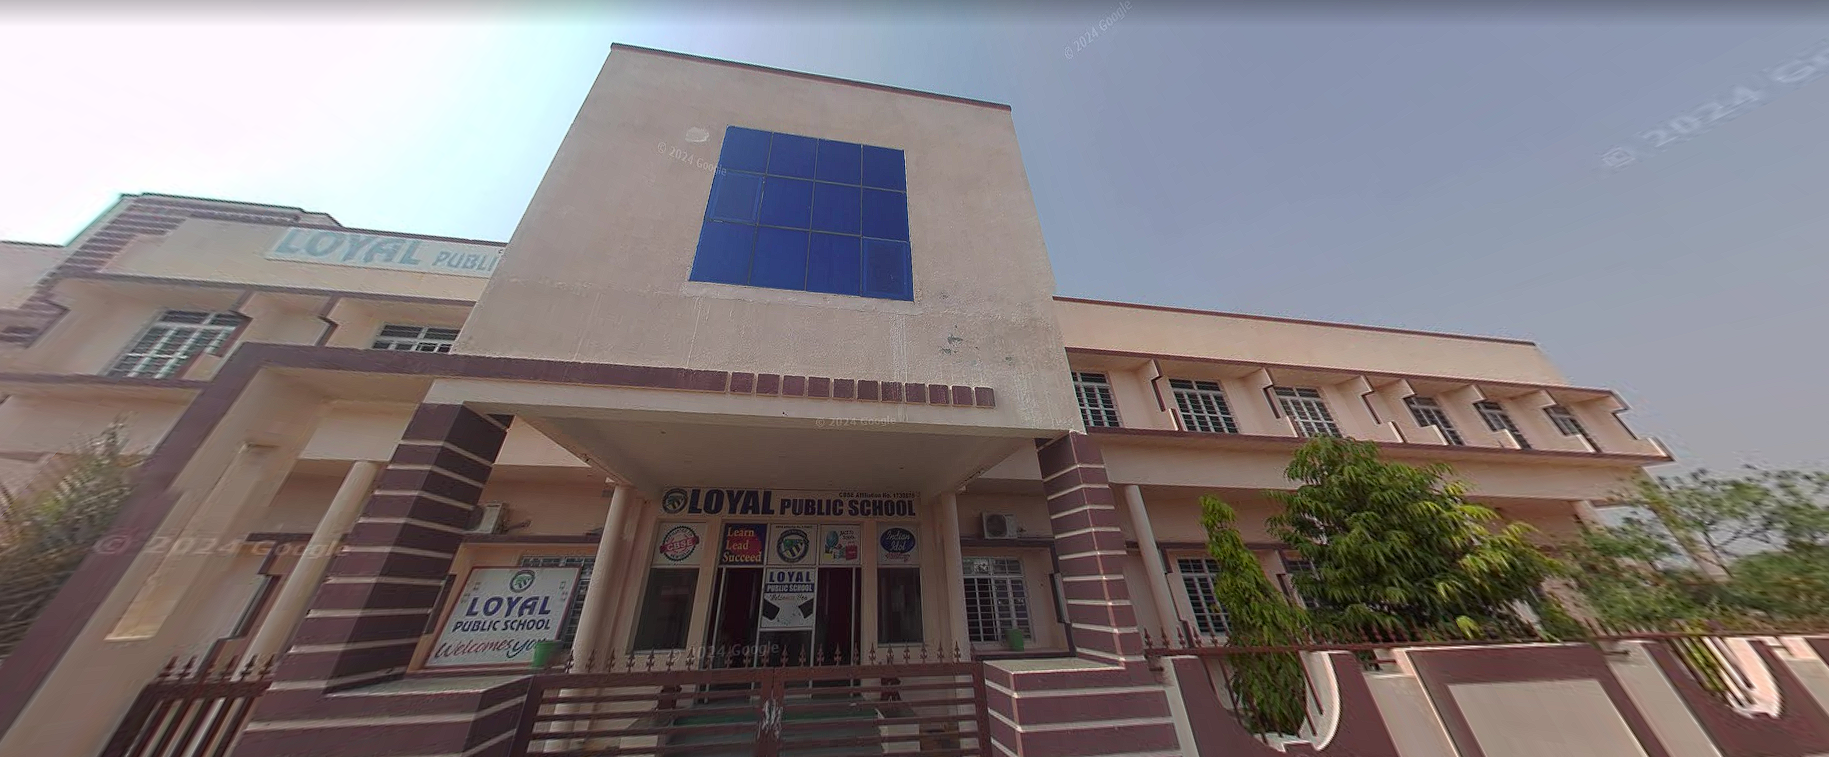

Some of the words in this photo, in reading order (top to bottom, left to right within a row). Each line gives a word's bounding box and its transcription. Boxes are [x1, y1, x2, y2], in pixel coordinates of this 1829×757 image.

[273, 227, 422, 265] LOYAL
[687, 488, 775, 515] LOYAL
[779, 498, 844, 516] PUBLIC
[848, 499, 916, 517] SCHOOL
[727, 526, 755, 537] Learn
[886, 530, 911, 540] Indian
[666, 538, 694, 551] CBSE
[725, 540, 749, 550] Lead
[890, 540, 907, 551] Idol
[722, 551, 762, 562] Succeed
[768, 571, 812, 583] LOYAL
[766, 584, 789, 592] PUBLIC
[789, 584, 813, 592] SCHOOL
[465, 596, 551, 618] LOYAL
[451, 619, 501, 633] PUBLIC
[501, 618, 551, 632] SCHOOL
[434, 638, 512, 659] Welcomes
